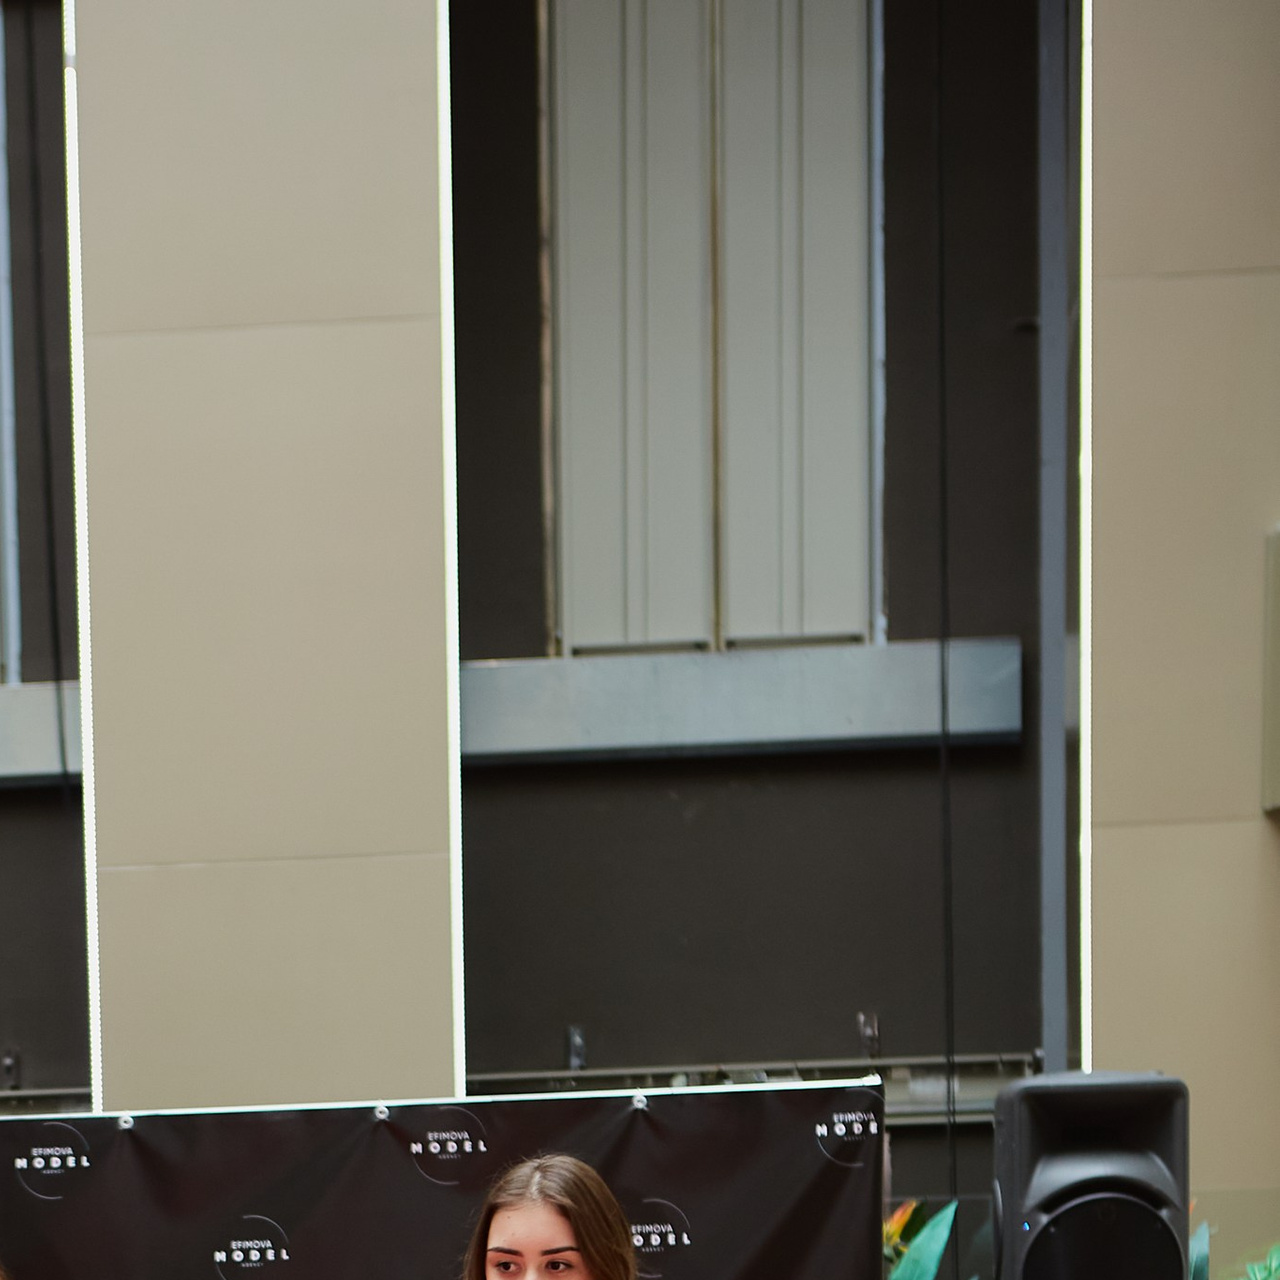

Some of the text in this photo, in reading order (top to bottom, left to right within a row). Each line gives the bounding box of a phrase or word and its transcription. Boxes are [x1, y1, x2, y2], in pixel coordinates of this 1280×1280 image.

[426, 1130, 470, 1141] EFIMOVA
[31, 1146, 74, 1156] EFIMOVA
[409, 1139, 488, 1155] MODEL
[14, 1155, 91, 1170] MODEL
[630, 1223, 674, 1234] EFIMOVA
[230, 1239, 273, 1250] EFIMOVA
[213, 1248, 290, 1263] MODEL
